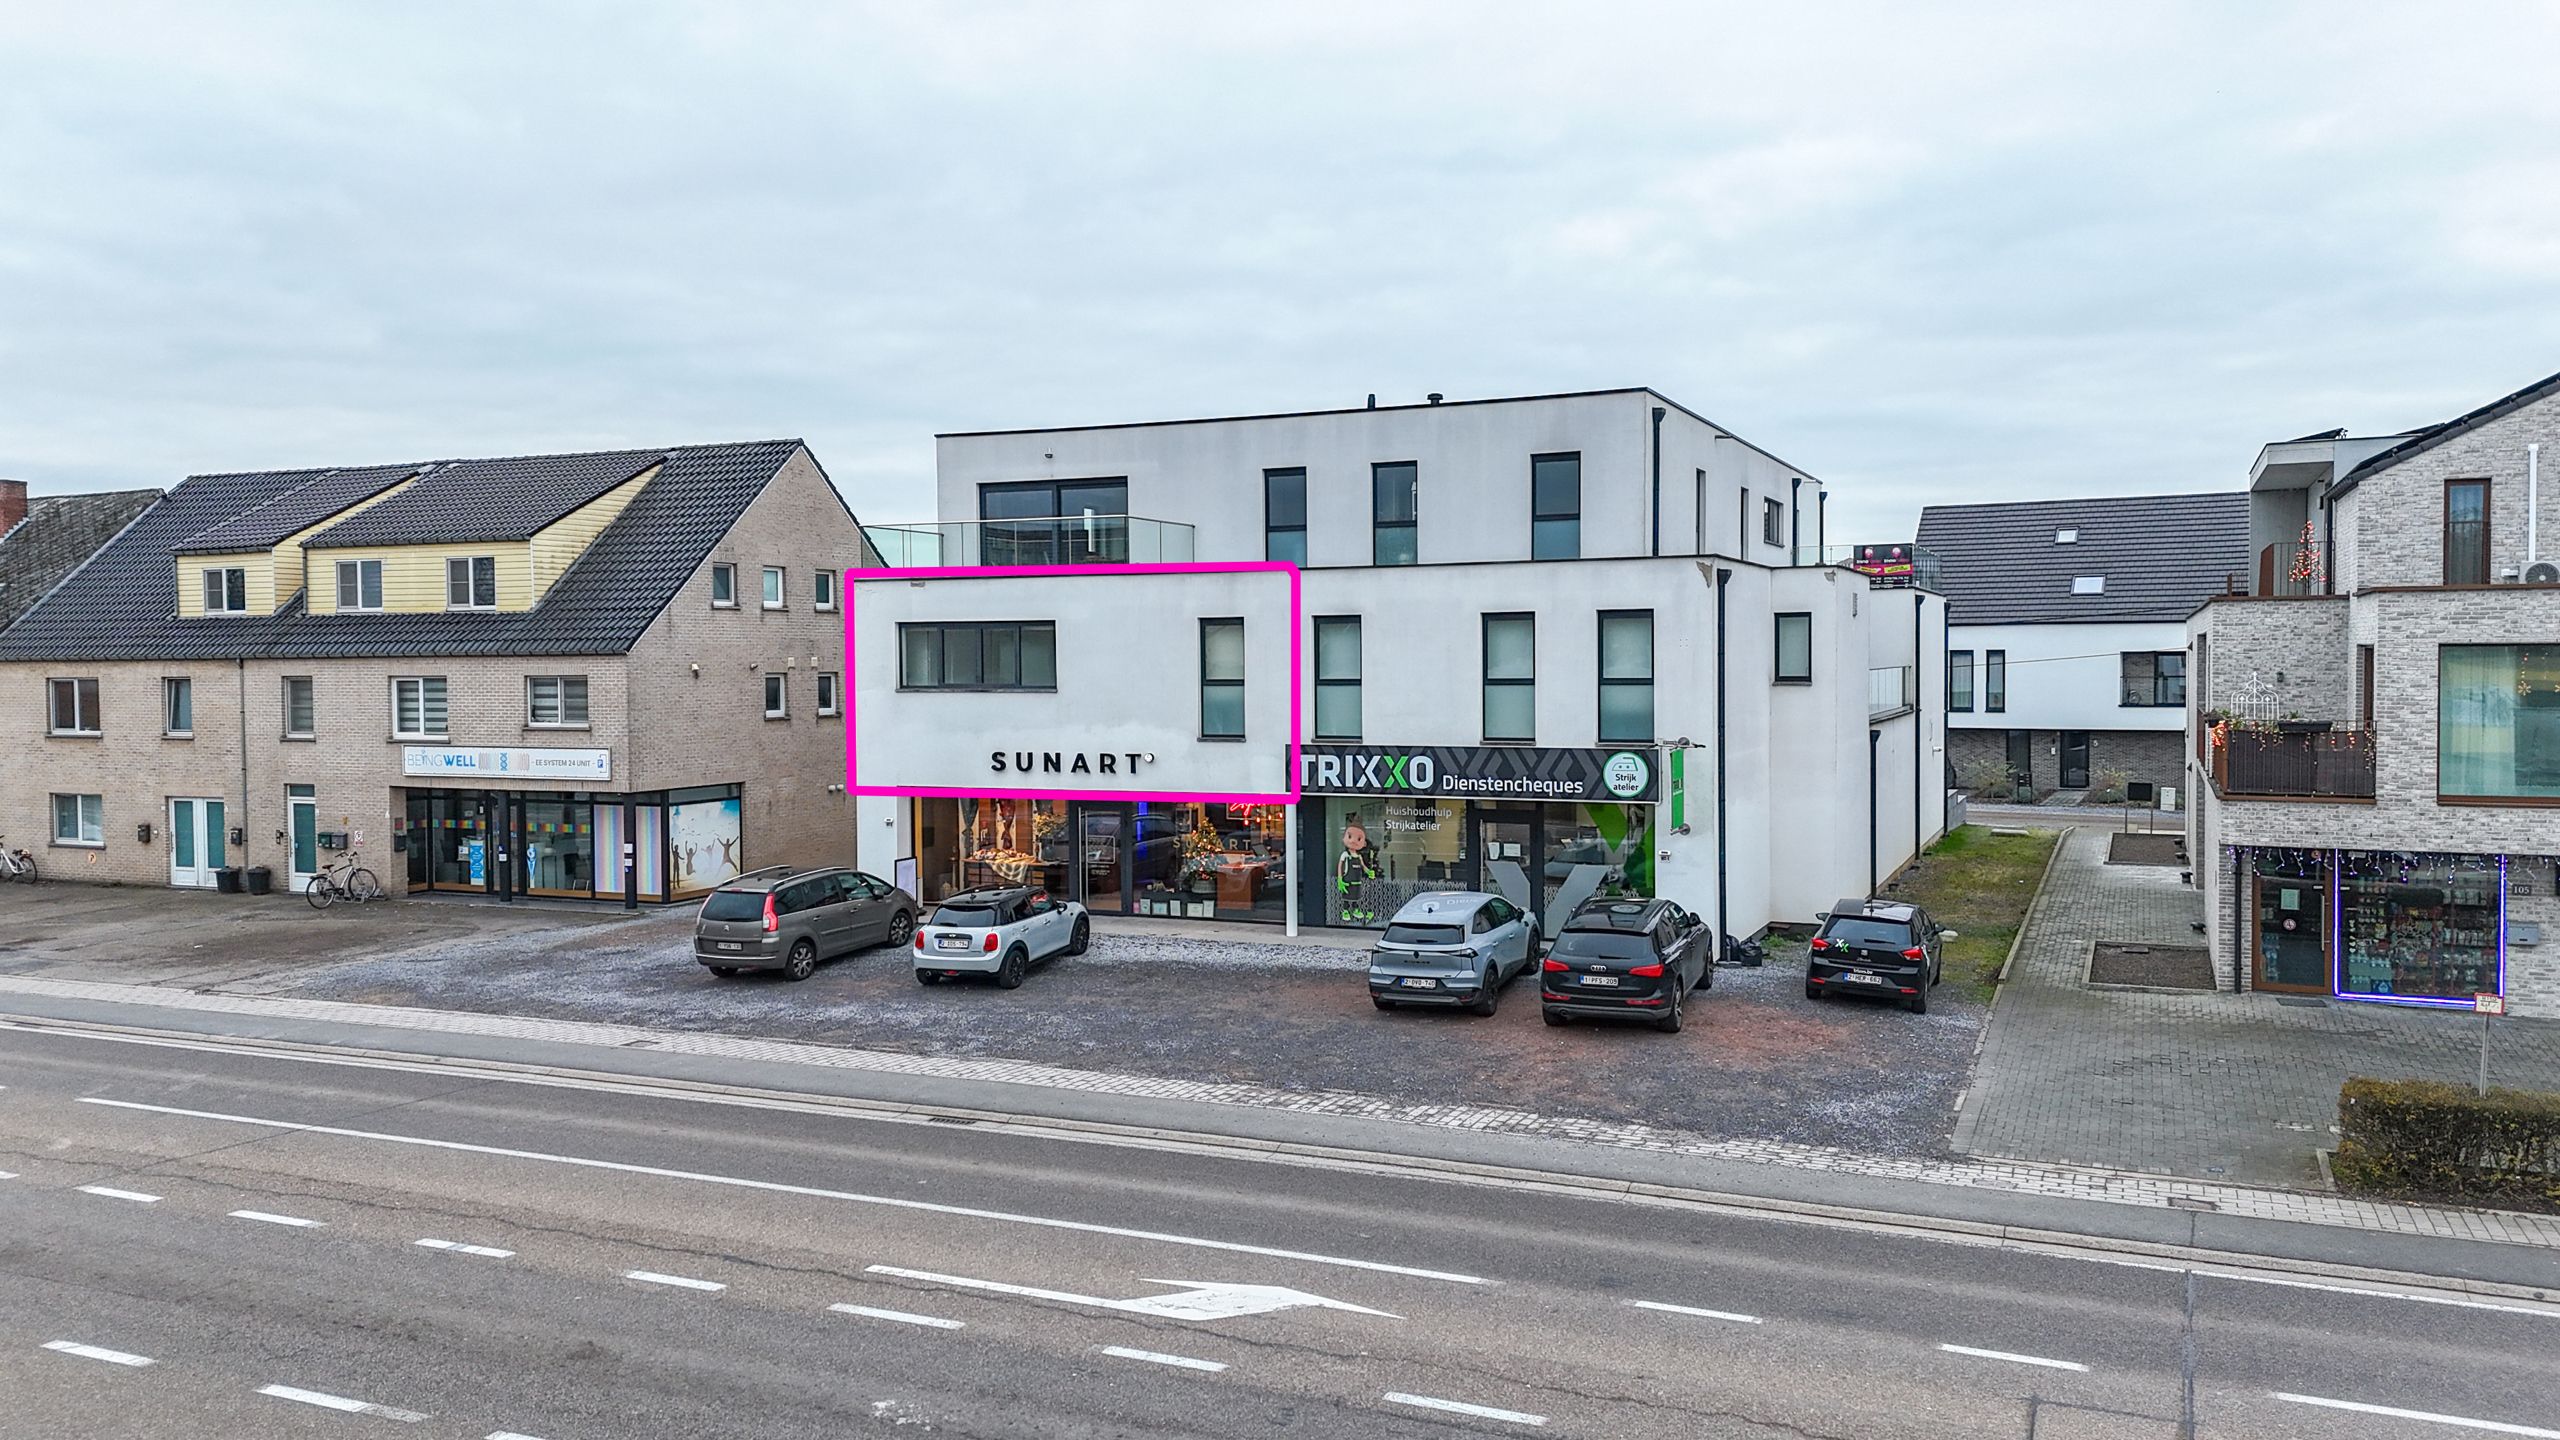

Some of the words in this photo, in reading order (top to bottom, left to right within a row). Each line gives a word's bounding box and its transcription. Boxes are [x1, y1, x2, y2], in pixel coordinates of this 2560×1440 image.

[544, 759, 567, 767] SYSTEM
[991, 751, 1142, 774] SUNART
[1300, 753, 1434, 789] TRIXXO
[1442, 775, 1584, 796] Dienstencheques
[1615, 773, 1637, 782] Strijk
[1613, 783, 1639, 791] atelier
[1385, 806, 1452, 819] Huishoudhulp
[1385, 820, 1442, 832] Strijkatelier
[1173, 838, 1252, 851] SUART
[2514, 886, 2530, 895] 105
